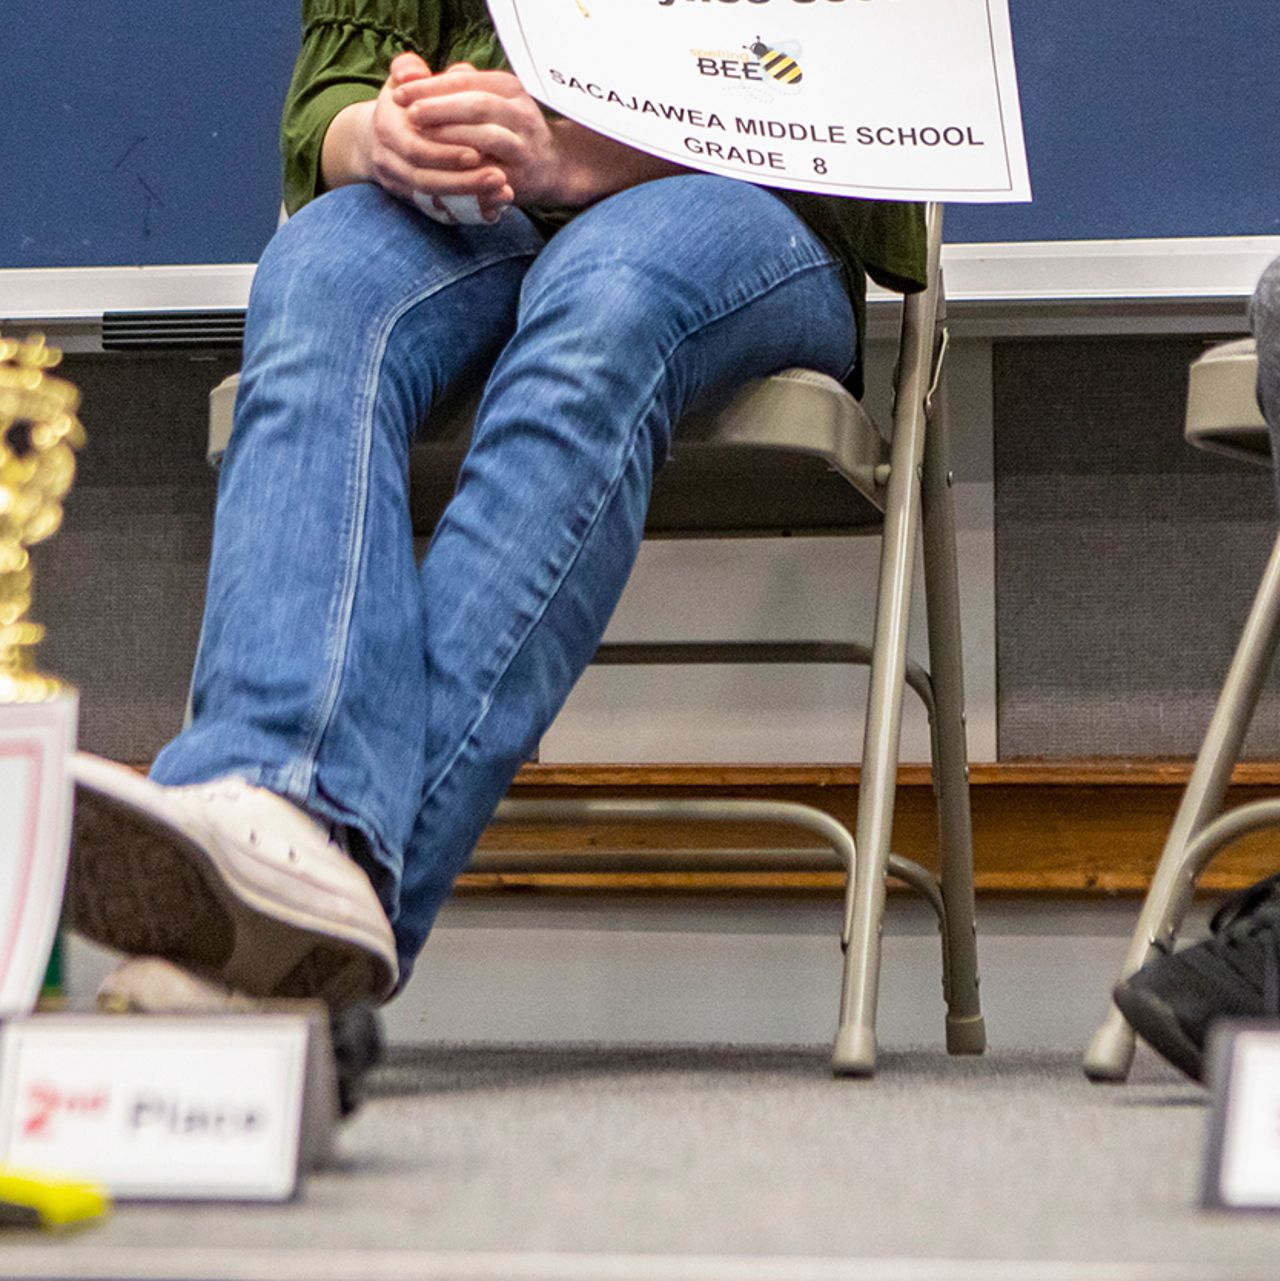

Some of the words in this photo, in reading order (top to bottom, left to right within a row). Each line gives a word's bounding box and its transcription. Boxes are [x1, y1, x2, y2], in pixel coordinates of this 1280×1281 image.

[696, 57, 763, 81] BEE
[548, 68, 728, 132] SACAJAWEA
[735, 117, 847, 145] MIDDLE
[856, 125, 984, 147] SCHOOL
[683, 136, 786, 171] GRADE
[812, 157, 828, 176] 8
